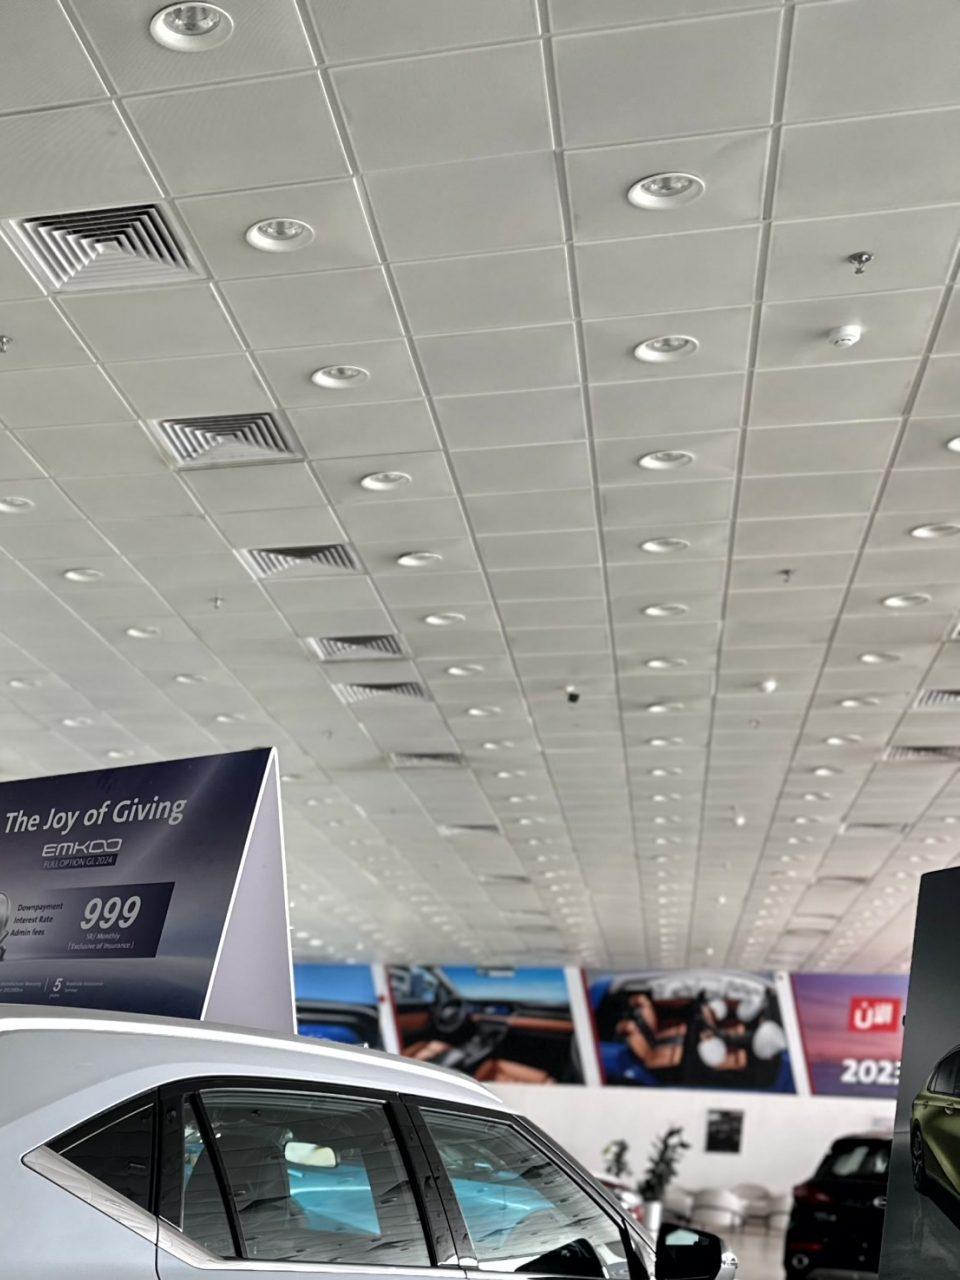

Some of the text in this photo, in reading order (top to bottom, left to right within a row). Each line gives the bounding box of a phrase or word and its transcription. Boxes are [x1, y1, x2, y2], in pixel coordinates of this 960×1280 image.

[5, 796, 187, 836] The Joy of Giving
[41, 838, 123, 857] EMKOO
[43, 859, 59, 869] FULL
[59, 857, 85, 868] OPTION
[95, 855, 113, 865] 2024
[17, 902, 64, 913] Downpayment
[80, 895, 142, 930] 999
[13, 915, 54, 924] Interest Rate
[10, 929, 31, 937] Admin
[52, 977, 63, 991] 5
